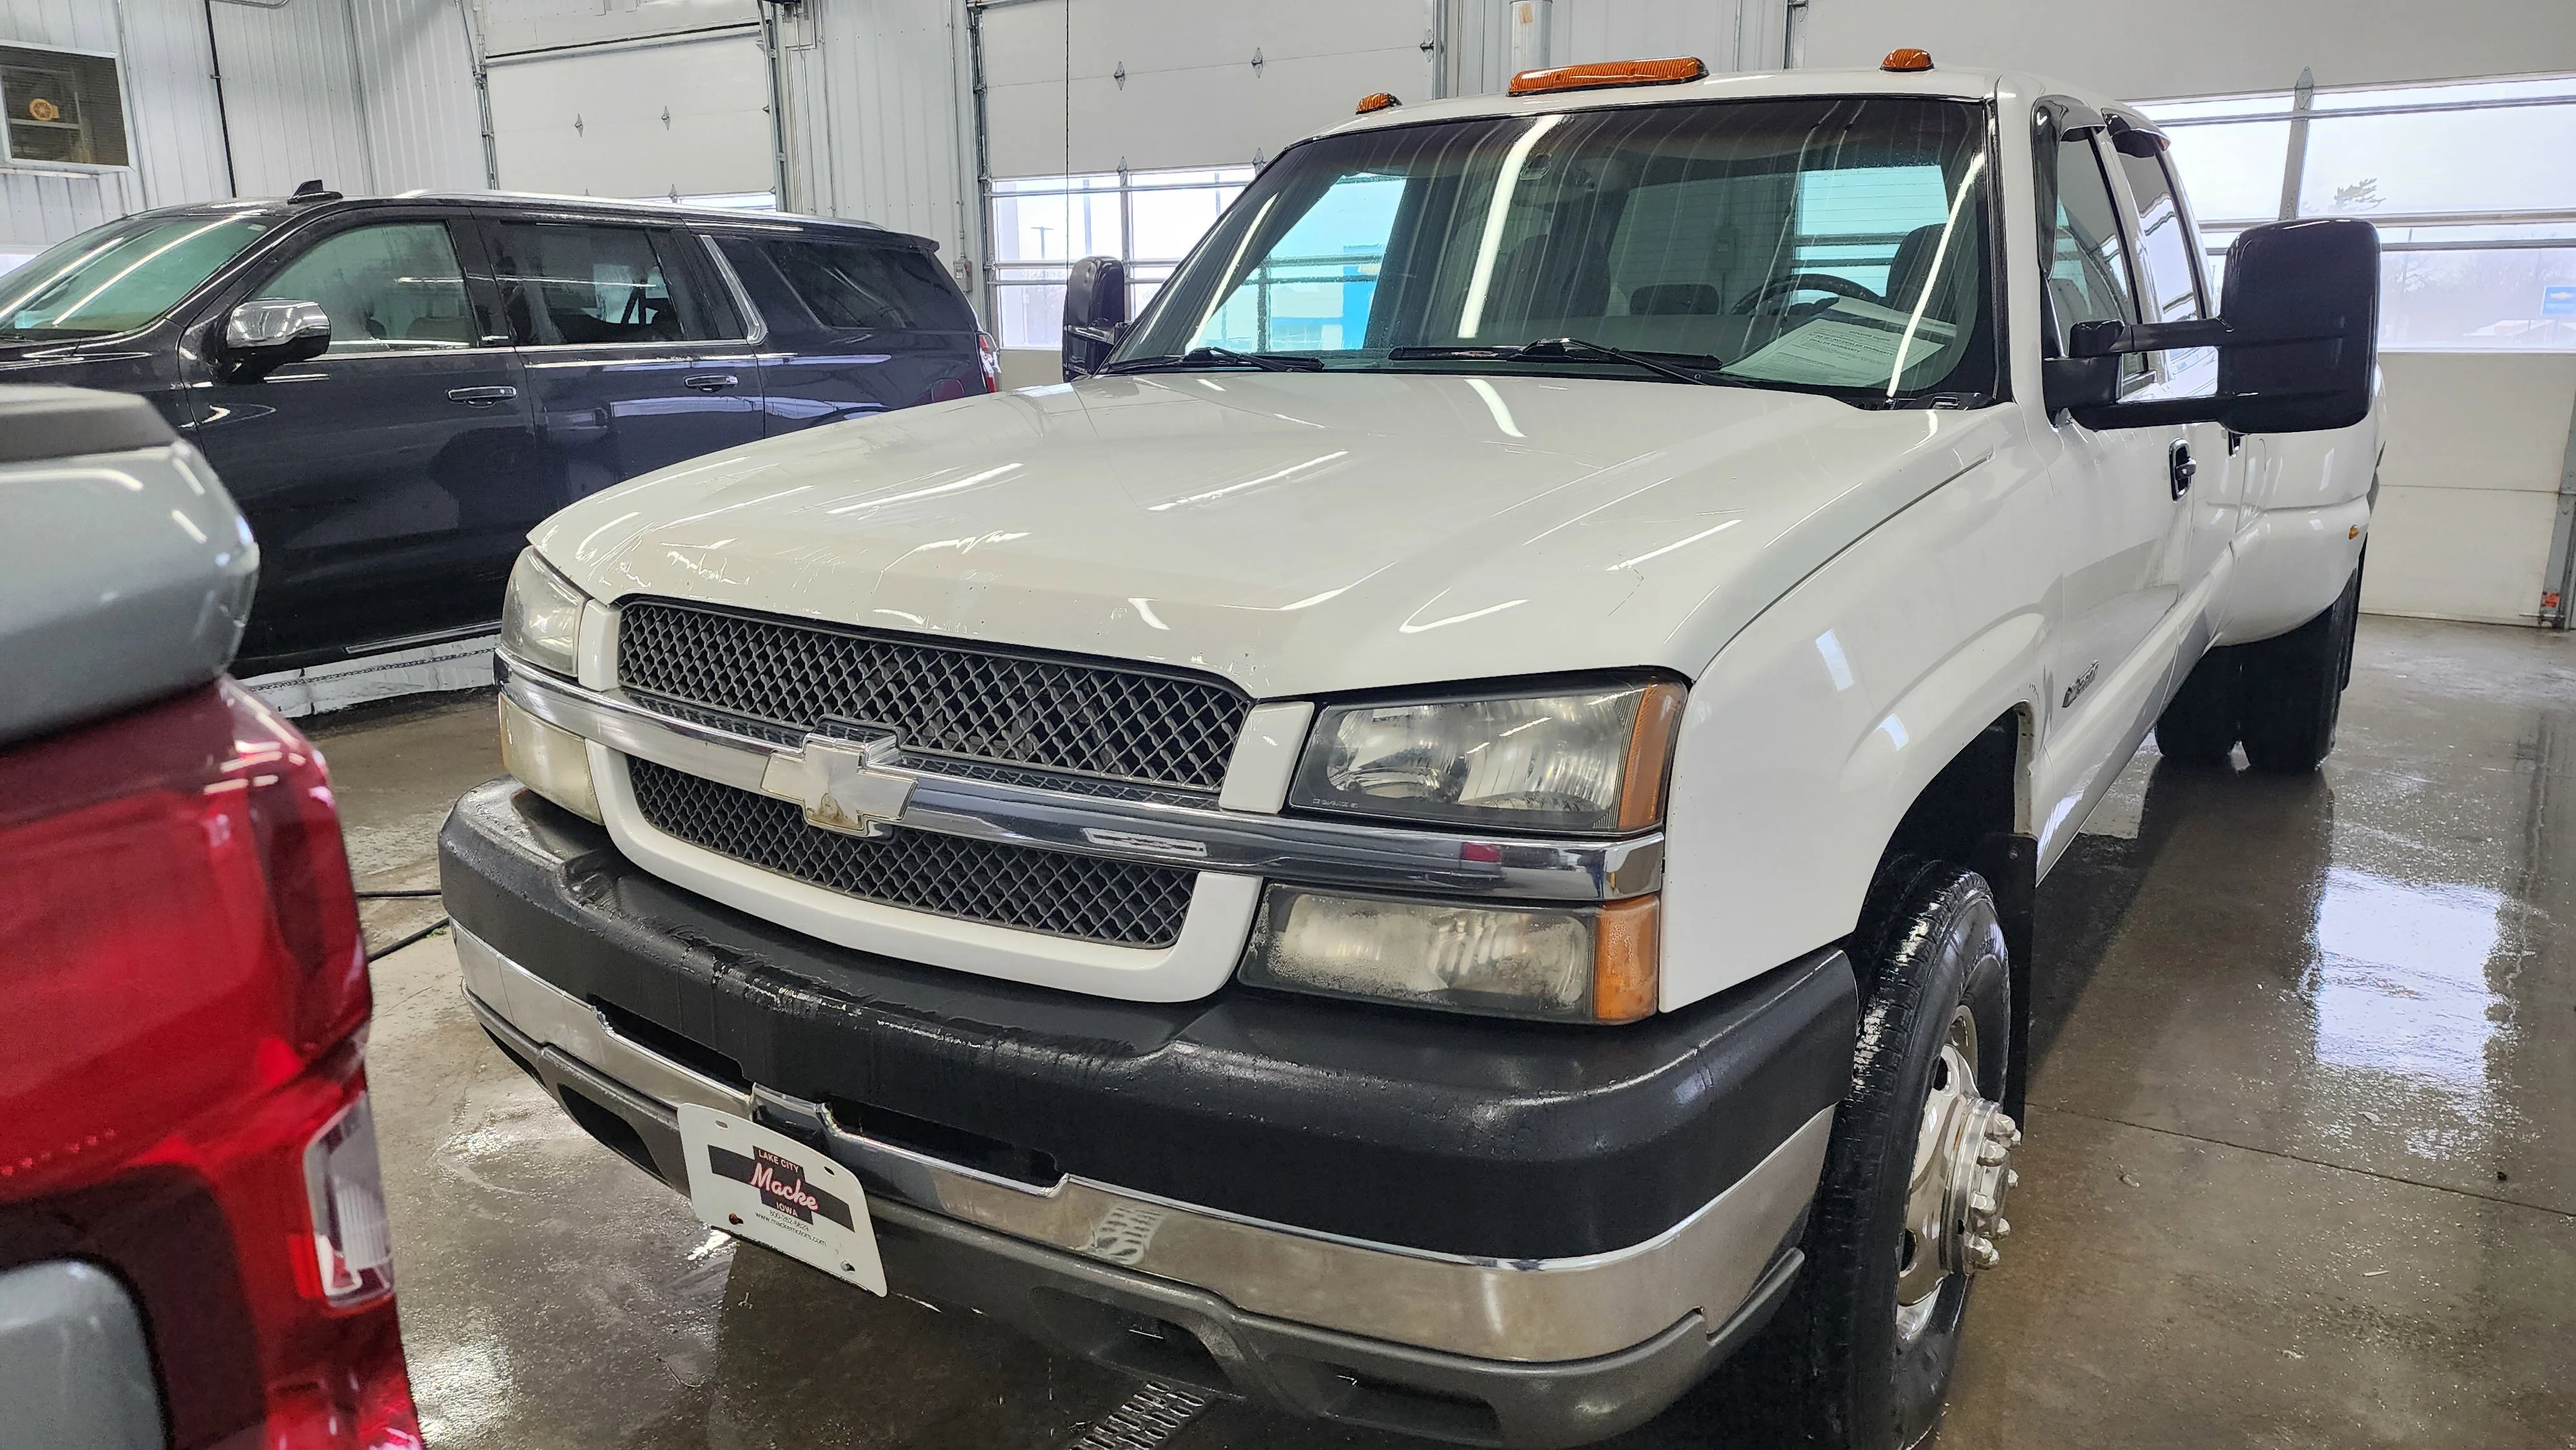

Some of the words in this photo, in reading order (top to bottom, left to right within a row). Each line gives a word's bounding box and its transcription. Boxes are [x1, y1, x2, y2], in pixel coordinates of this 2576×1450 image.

[759, 1149, 779, 1165] LAKE
[781, 1159, 799, 1173] CITY
[750, 1162, 819, 1210] Macke
[776, 1201, 798, 1217] IOWA
